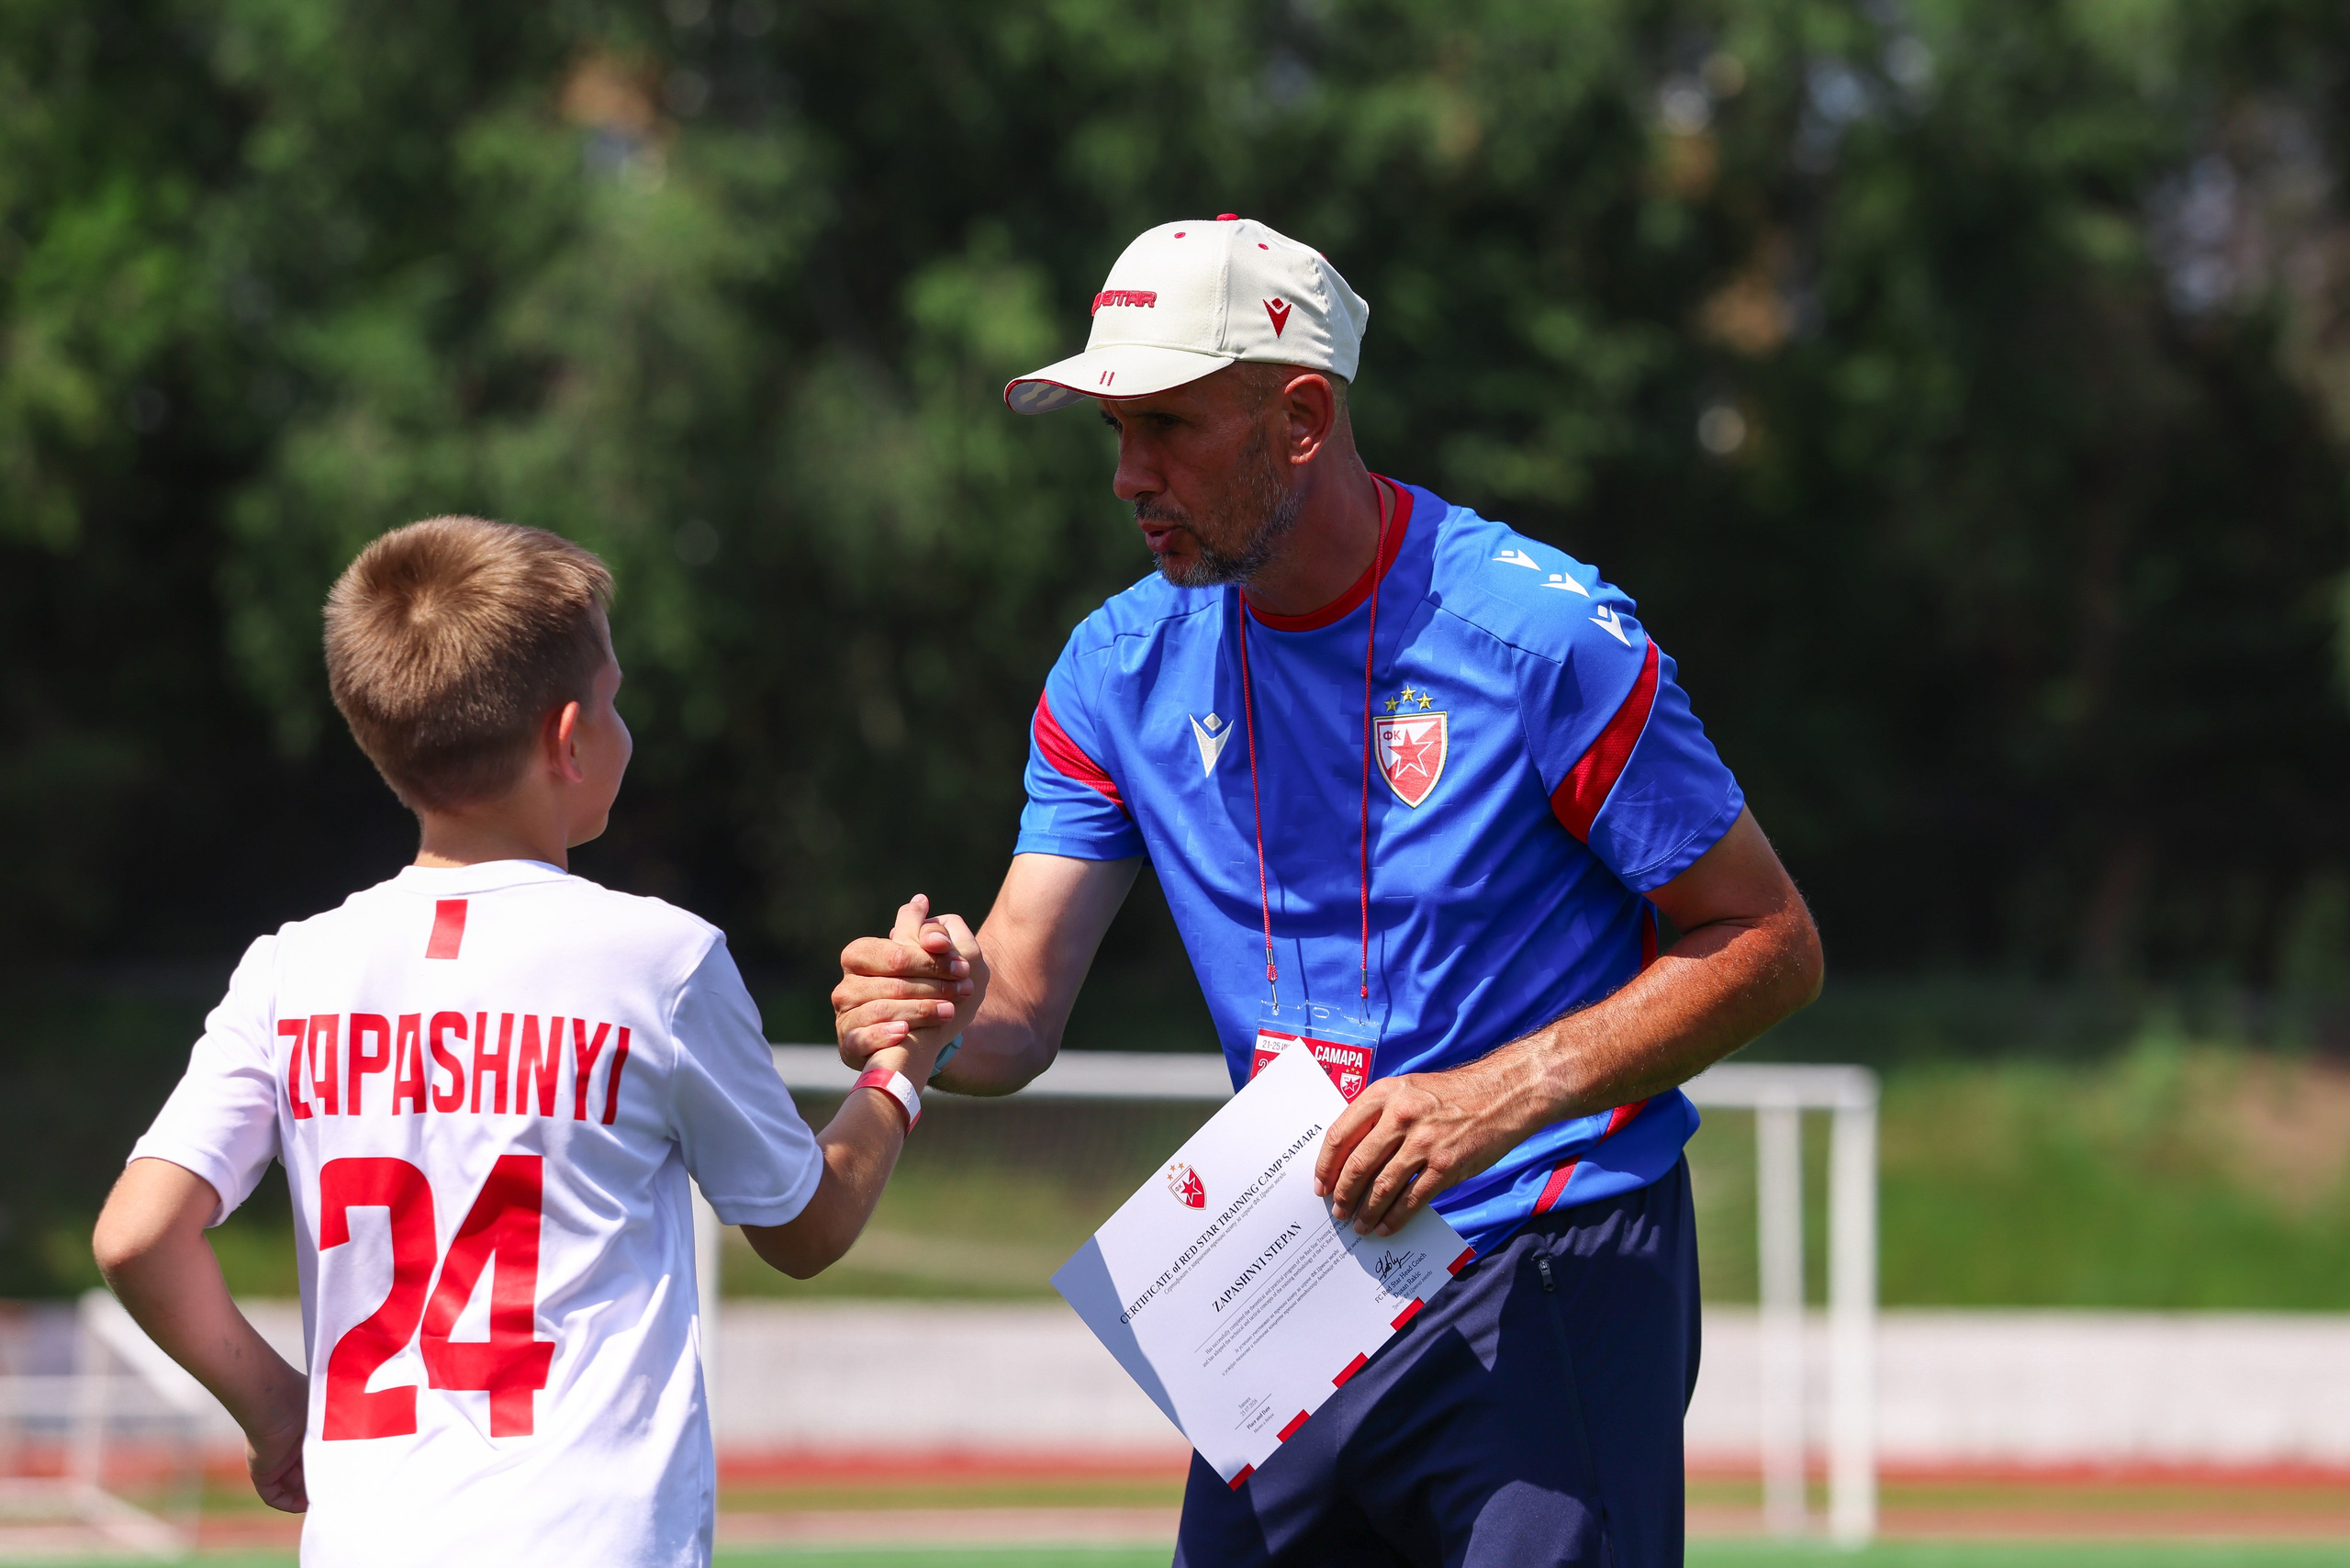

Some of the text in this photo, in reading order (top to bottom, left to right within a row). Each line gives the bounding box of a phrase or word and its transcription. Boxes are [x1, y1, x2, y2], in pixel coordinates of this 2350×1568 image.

[1382, 730, 1401, 741] ФК
[277, 1011, 631, 1126] ZAPASHNYI
[1261, 1039, 1281, 1051] 21-25
[1315, 1045, 1363, 1069] САМАРА
[1119, 1122, 1322, 1325] CERTIFICATE of RED STAR TRAINING CAMP SAMARA
[1212, 1221, 1302, 1312] ZAPASHNYI STEPAN
[1212, 1329, 1230, 1348] successfully
[1229, 1315, 1246, 1330] completed
[1249, 1294, 1265, 1310] theoretical
[1317, 1229, 1330, 1243] Training
[1375, 1252, 1427, 1303] FC Red Star Head Coach
[1393, 1271, 1421, 1298] Dusan Rakic
[319, 1154, 556, 1441] 24
[1214, 1343, 1226, 1357] adopted
[1230, 1325, 1244, 1339] technical
[1248, 1308, 1260, 1320] tactical
[1260, 1296, 1274, 1311] concepts
[1281, 1276, 1294, 1289] training
[1292, 1257, 1313, 1278] methodology
[1239, 1396, 1250, 1408] Samara
[1247, 1419, 1257, 1429] Place
[1262, 1406, 1270, 1415] Date
